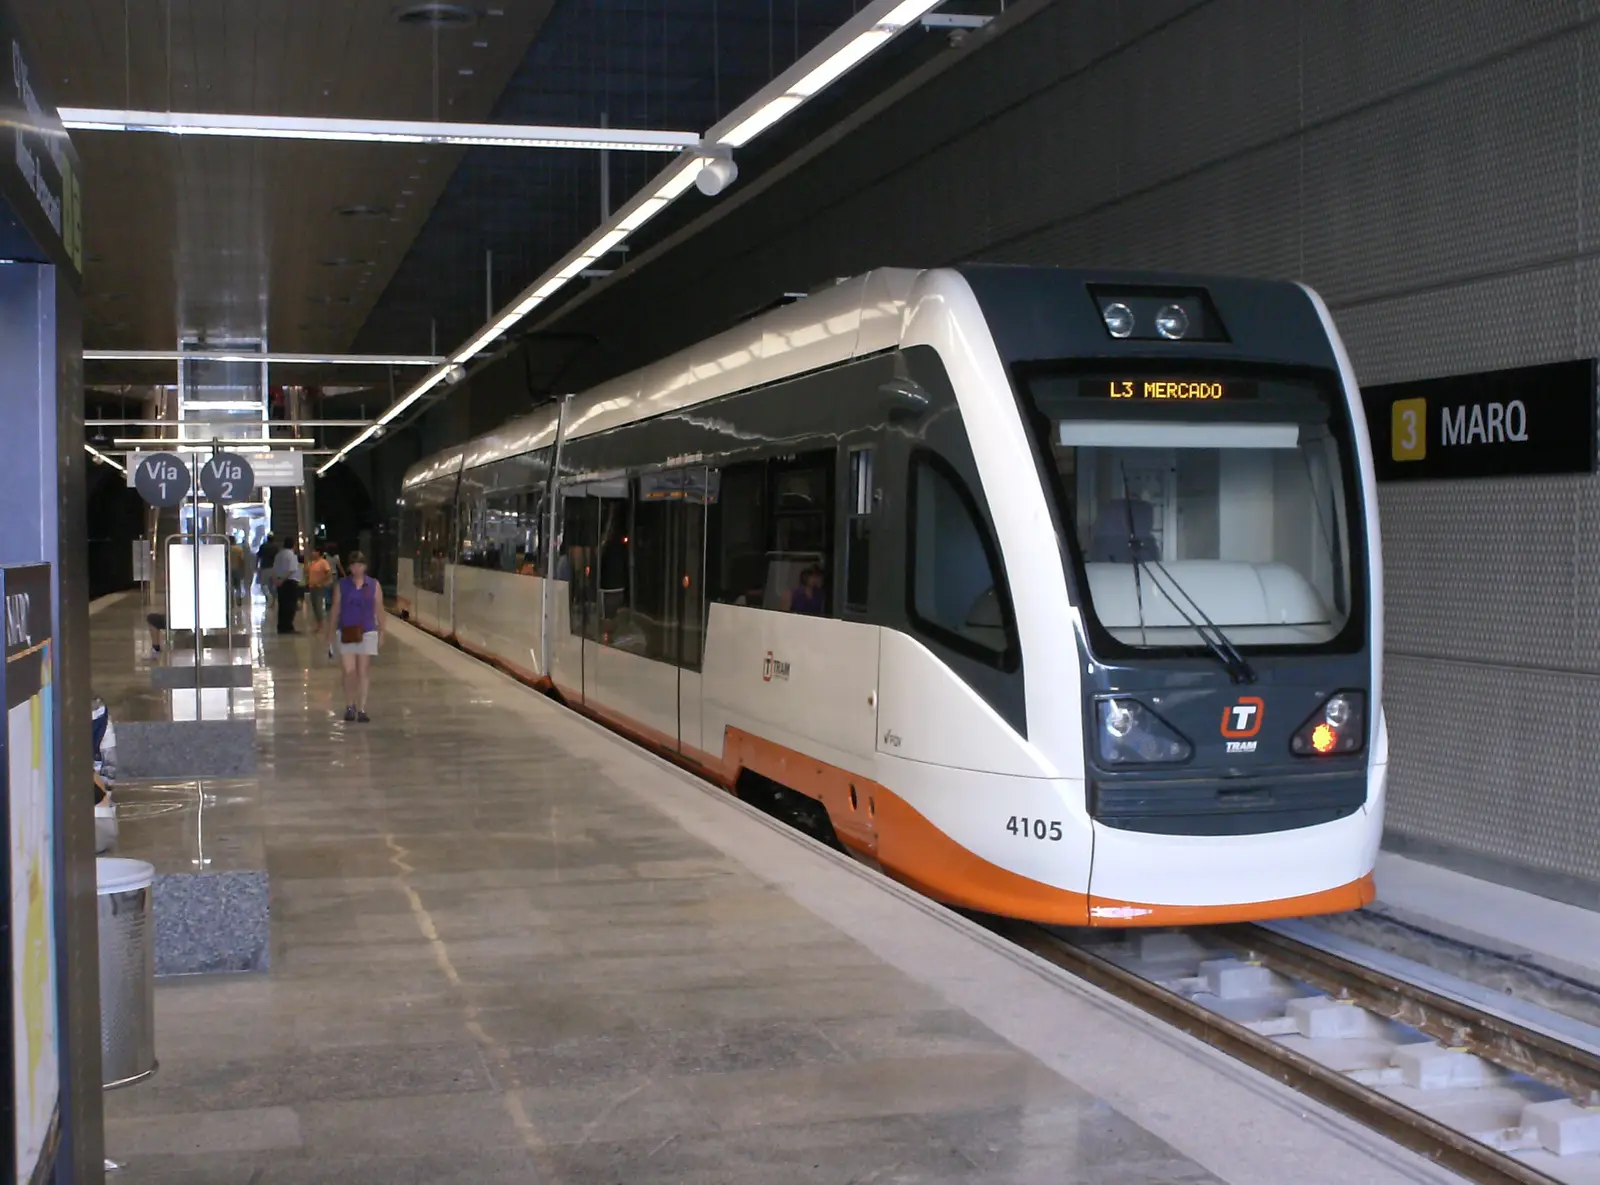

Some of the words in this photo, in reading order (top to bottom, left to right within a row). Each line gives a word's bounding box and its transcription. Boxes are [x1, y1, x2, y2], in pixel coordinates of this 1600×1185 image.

[1110, 381, 1133, 398] L3
[1144, 382, 1222, 399] MERCADO
[1401, 410, 1417, 449] 3
[1441, 400, 1529, 446] MARQ
[157, 482, 167, 499] 1
[221, 482, 234, 499] 2
[773, 660, 791, 677] TRAM
[1226, 741, 1258, 752] TRAM
[1006, 815, 1063, 841] 4105
